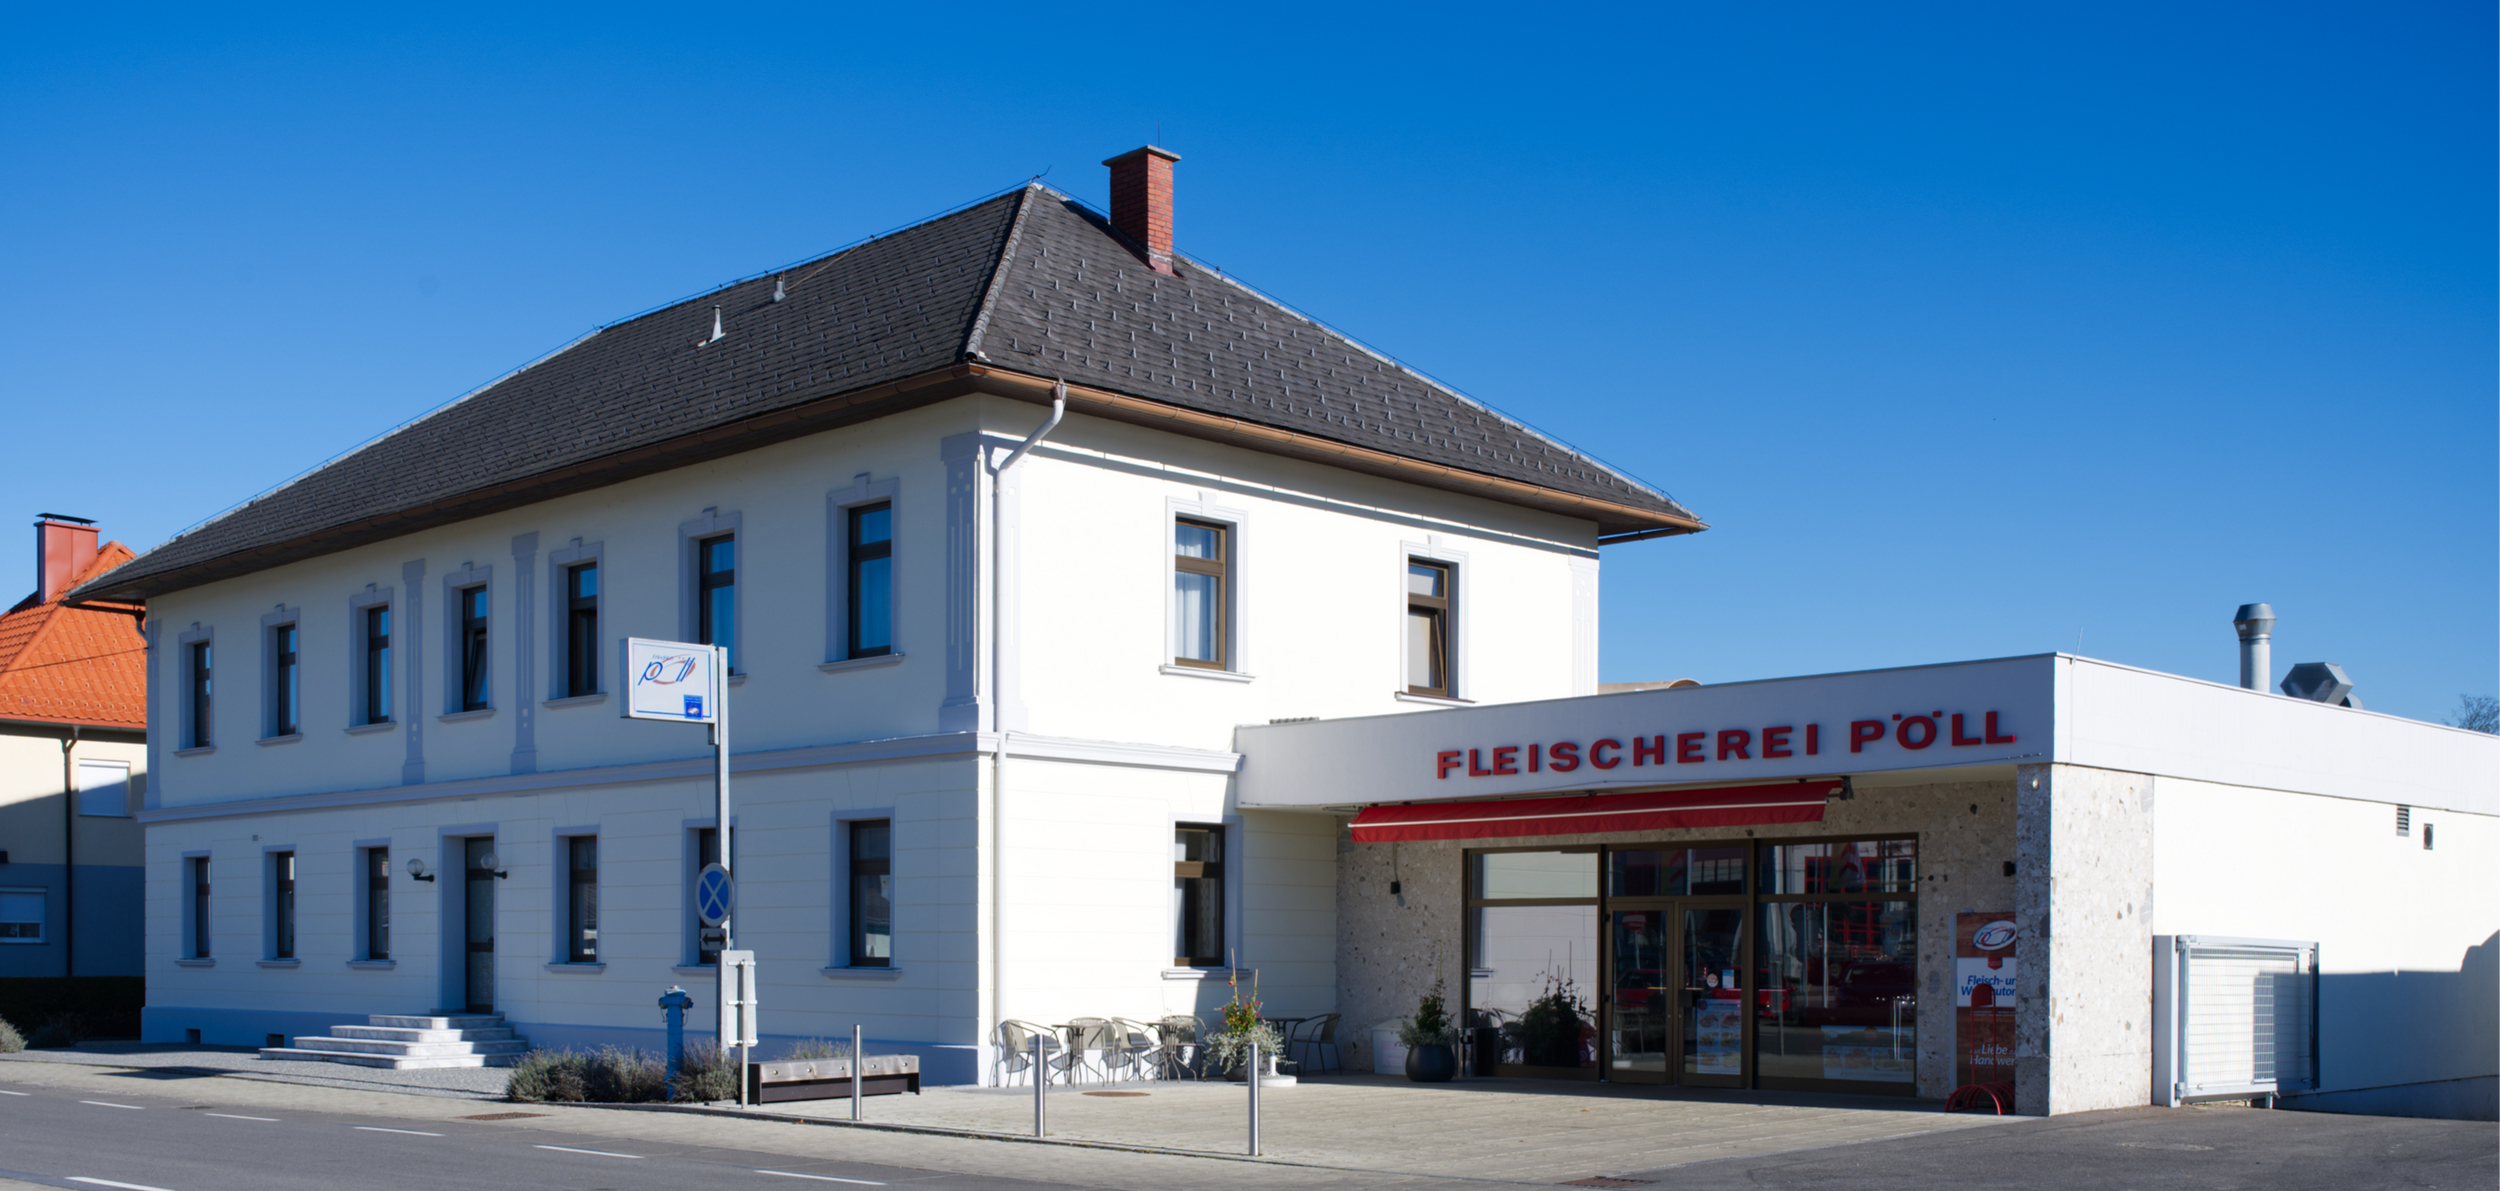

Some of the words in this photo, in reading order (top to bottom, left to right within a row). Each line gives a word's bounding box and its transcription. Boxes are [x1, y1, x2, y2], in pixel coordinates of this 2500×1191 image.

[1437, 723, 1819, 779] FLEISCHEREI
[1850, 710, 2016, 754] PÖLL
[1967, 975, 2004, 986] Fleisch-
[1981, 1043, 2008, 1055] Liebe
